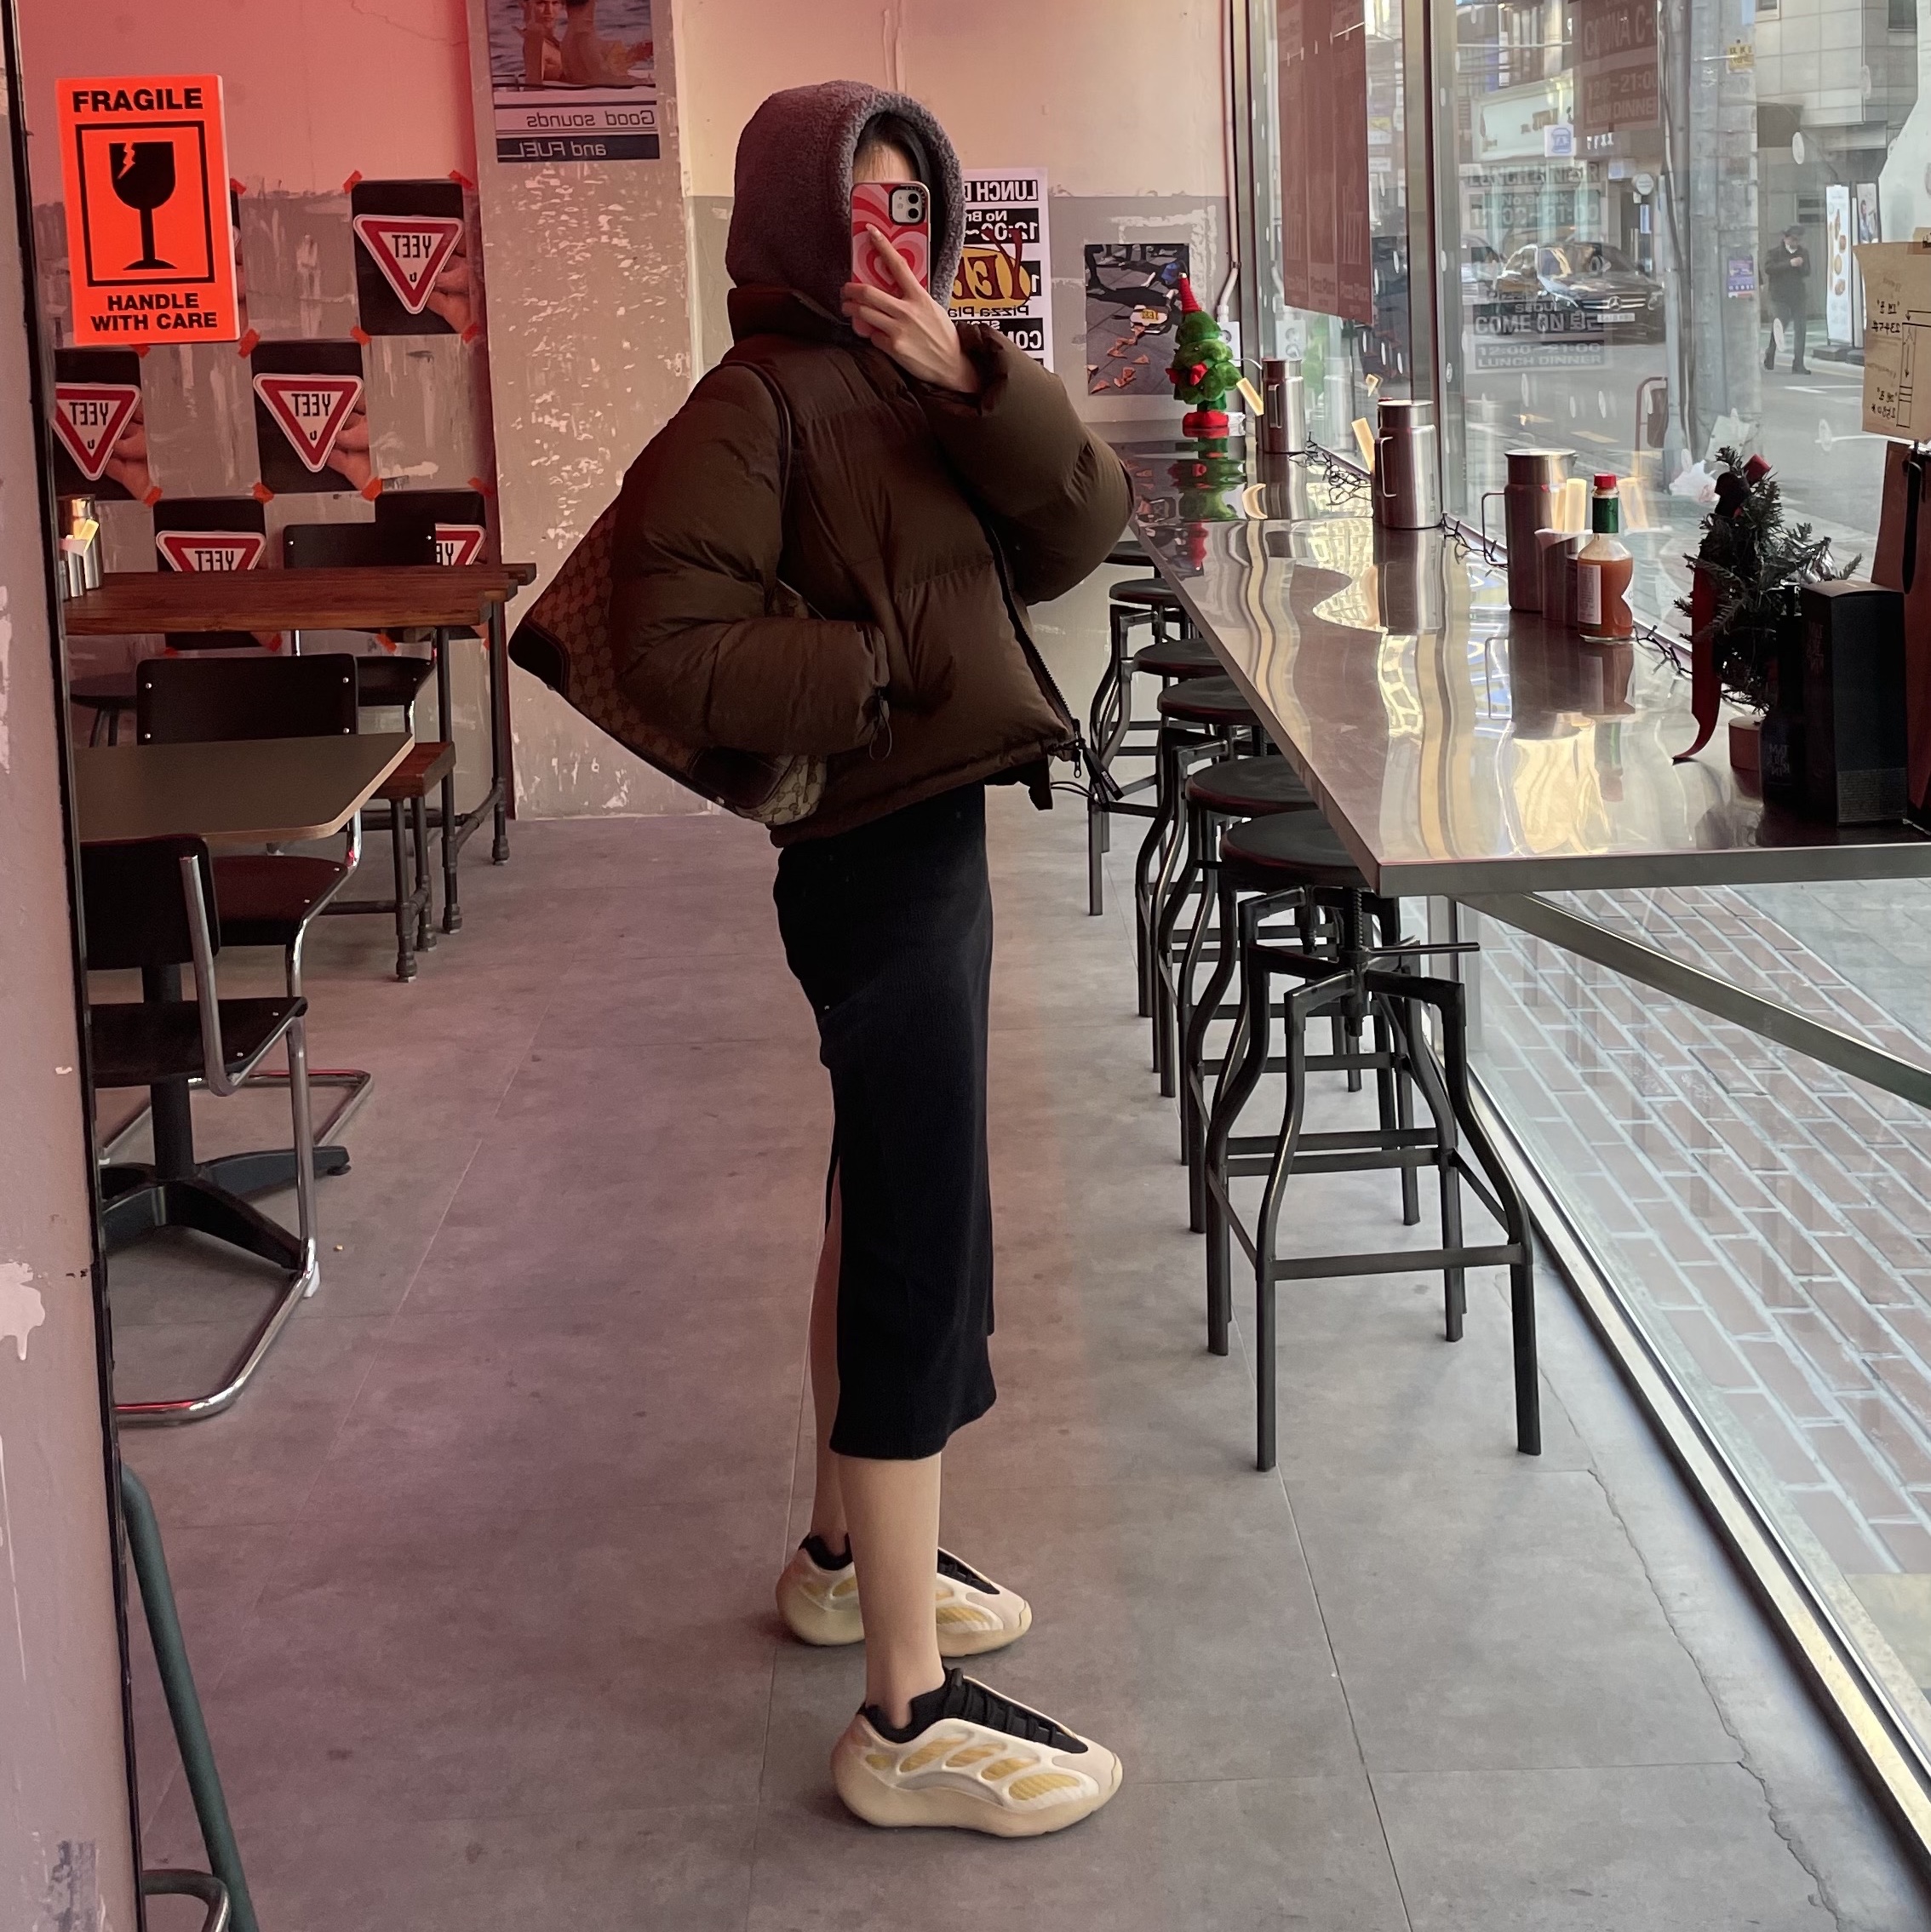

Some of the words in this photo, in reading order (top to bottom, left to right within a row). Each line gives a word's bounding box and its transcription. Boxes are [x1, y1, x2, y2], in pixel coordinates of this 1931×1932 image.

[72, 87, 204, 113] FRAGILE
[106, 291, 199, 312] HANDLE
[90, 312, 152, 332] WITH
[156, 310, 219, 330] CARE
[1475, 313, 1532, 335] COME
[1537, 312, 1564, 332] ON
[1477, 356, 1534, 369] LUNCH
[1538, 354, 1602, 366] DINNER
